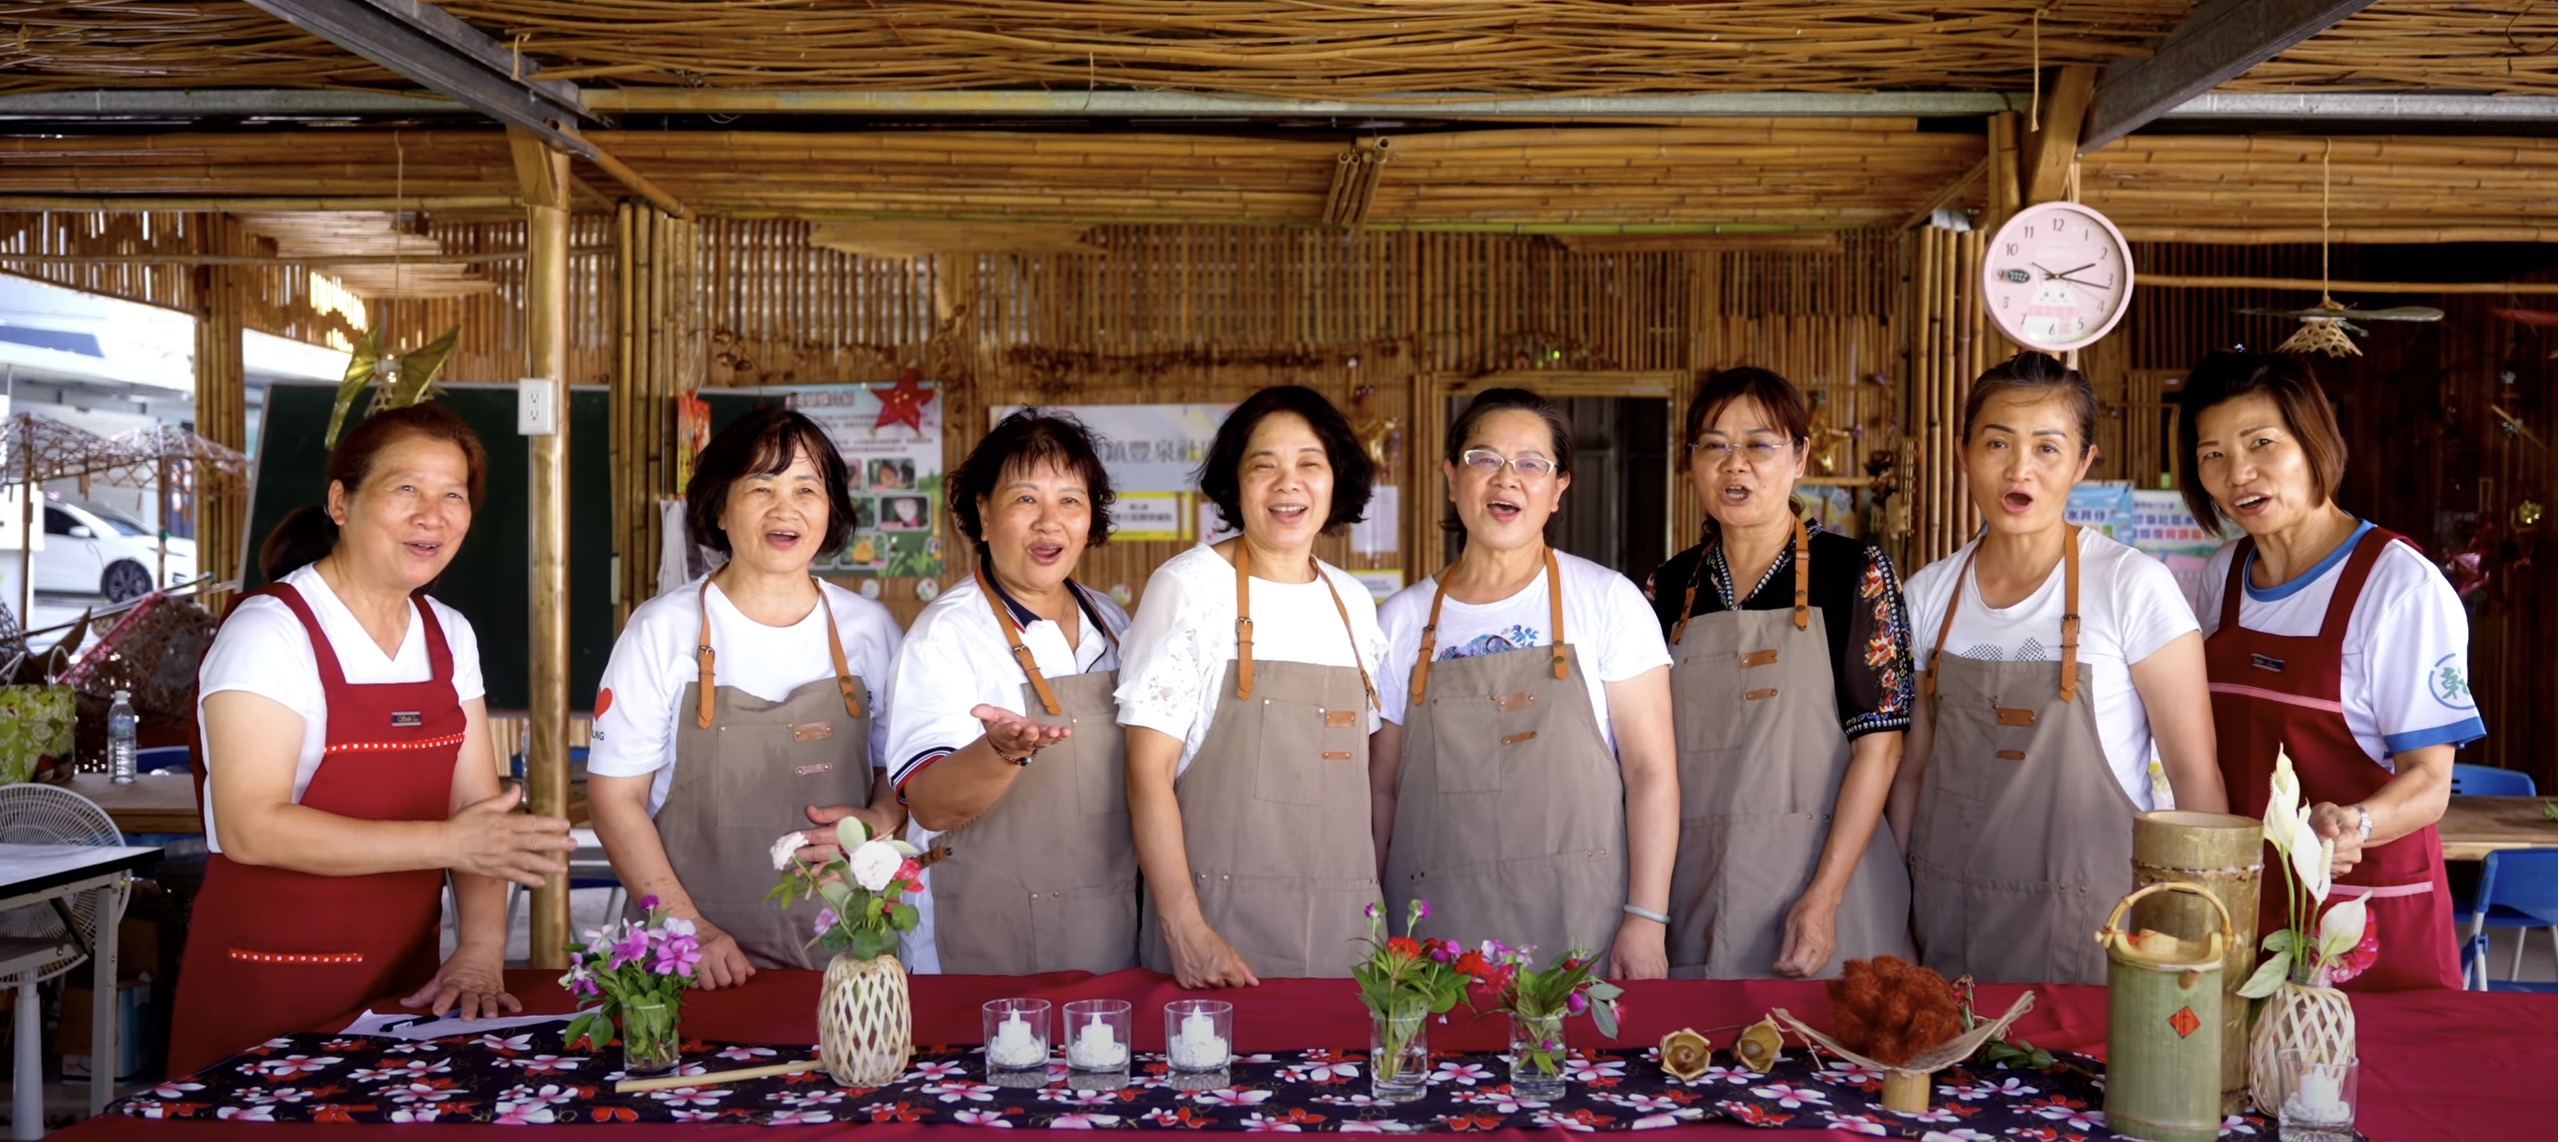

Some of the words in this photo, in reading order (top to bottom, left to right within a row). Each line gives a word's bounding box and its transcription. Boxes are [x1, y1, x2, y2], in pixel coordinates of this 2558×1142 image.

[2052, 218, 2064, 231] 12
[2024, 226, 2034, 239] 11
[2084, 229, 2089, 241] 1
[2006, 243, 2018, 256] 10
[2100, 247, 2108, 260] 2
[1997, 269, 2004, 281] 9
[2108, 274, 2114, 287] 3
[2003, 297, 2010, 309] 8
[2097, 300, 2105, 313] 4
[2020, 313, 2027, 326] 7
[2078, 318, 2084, 330] 5
[2048, 323, 2055, 336] 6
[1097, 439, 1207, 463] 鎮豐泉社
